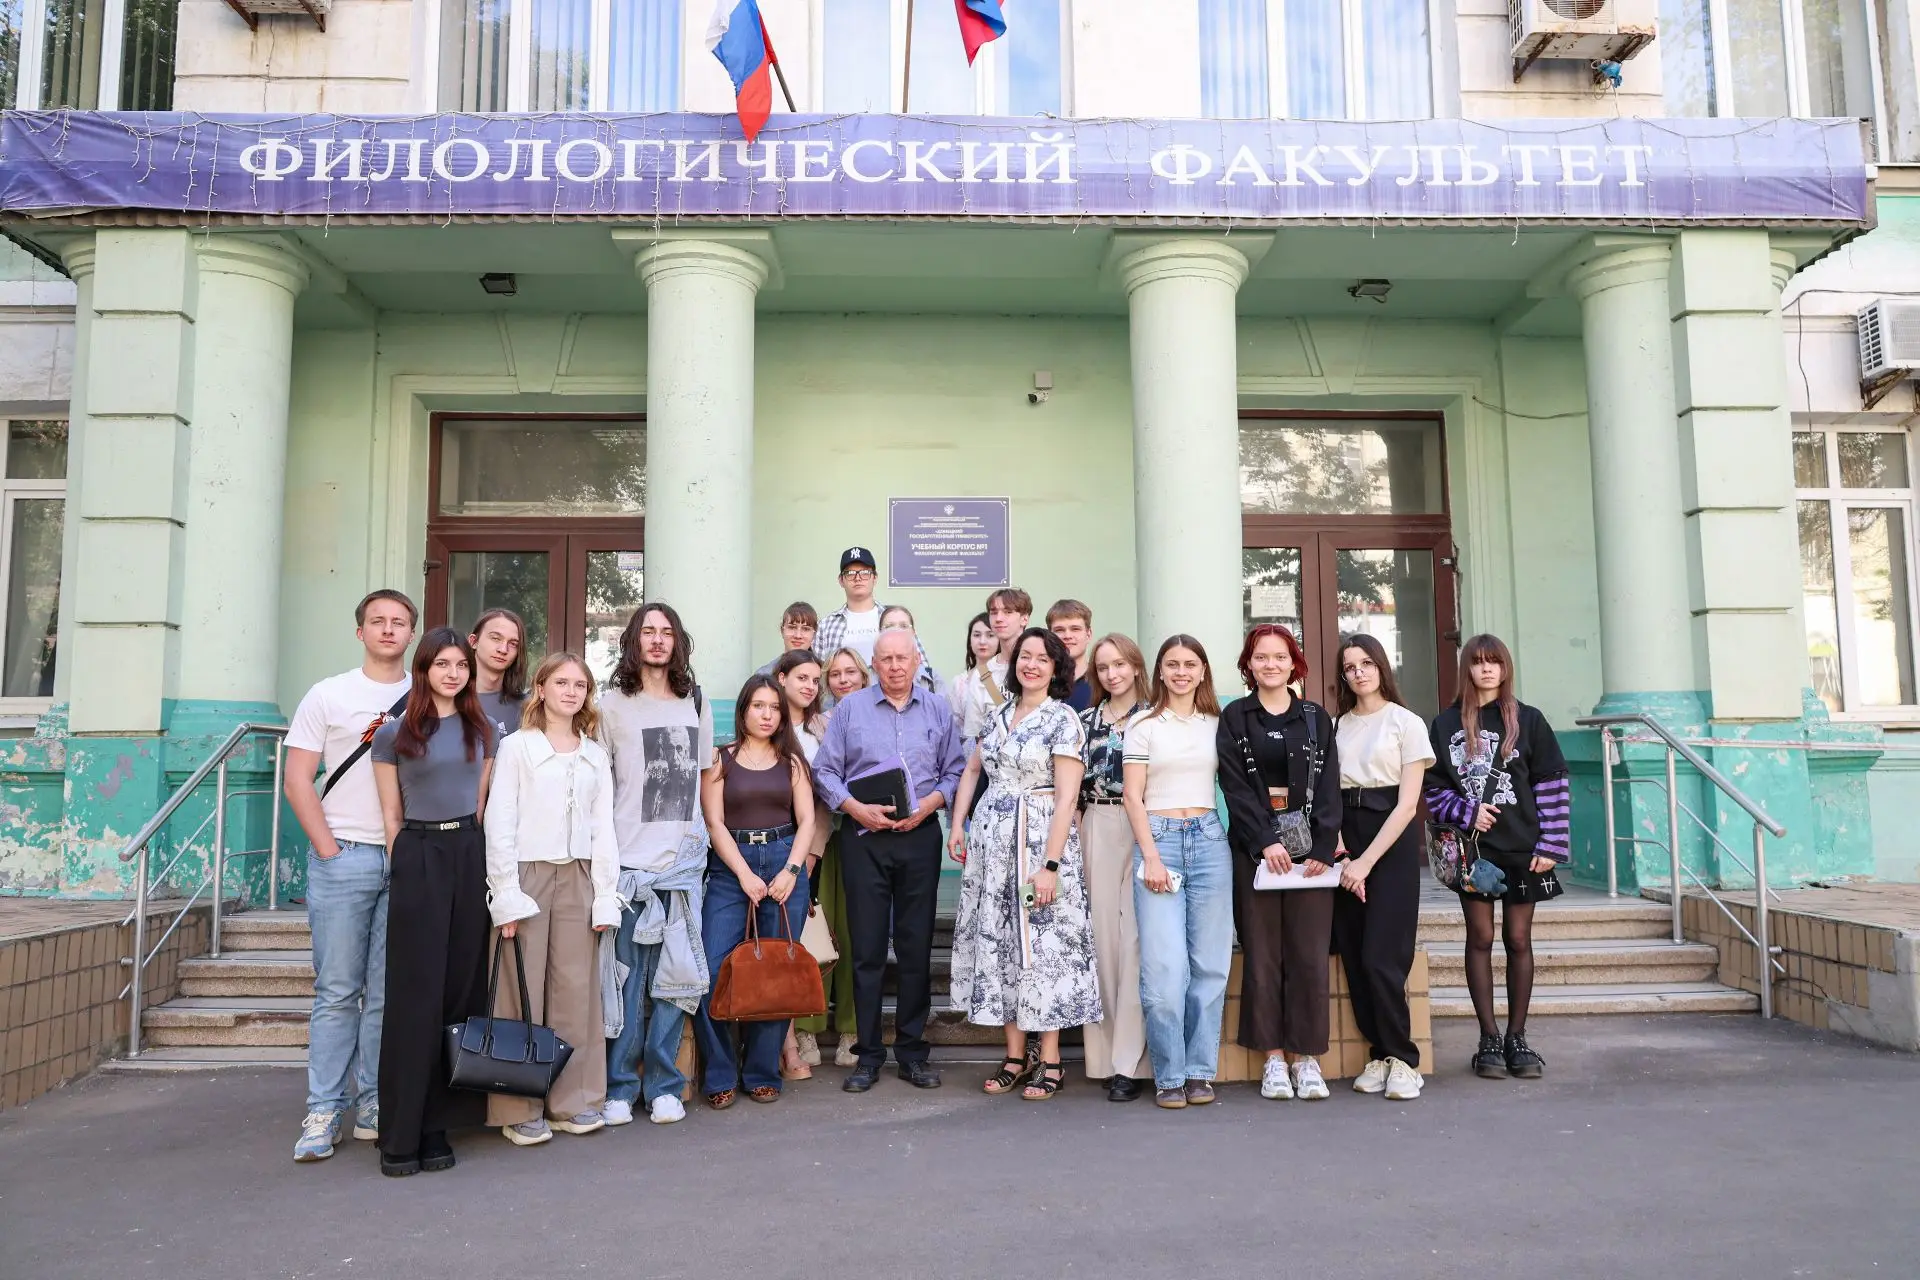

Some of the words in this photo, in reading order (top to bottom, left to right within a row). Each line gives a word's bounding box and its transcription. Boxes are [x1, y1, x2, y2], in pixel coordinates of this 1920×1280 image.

[240, 132, 1078, 184] ФИЛОЛОГИЧЕСКИЙ
[1151, 144, 1652, 187] ФАКУЛЬТЕТ
[911, 542, 946, 550] УЧЕБНЫЙ
